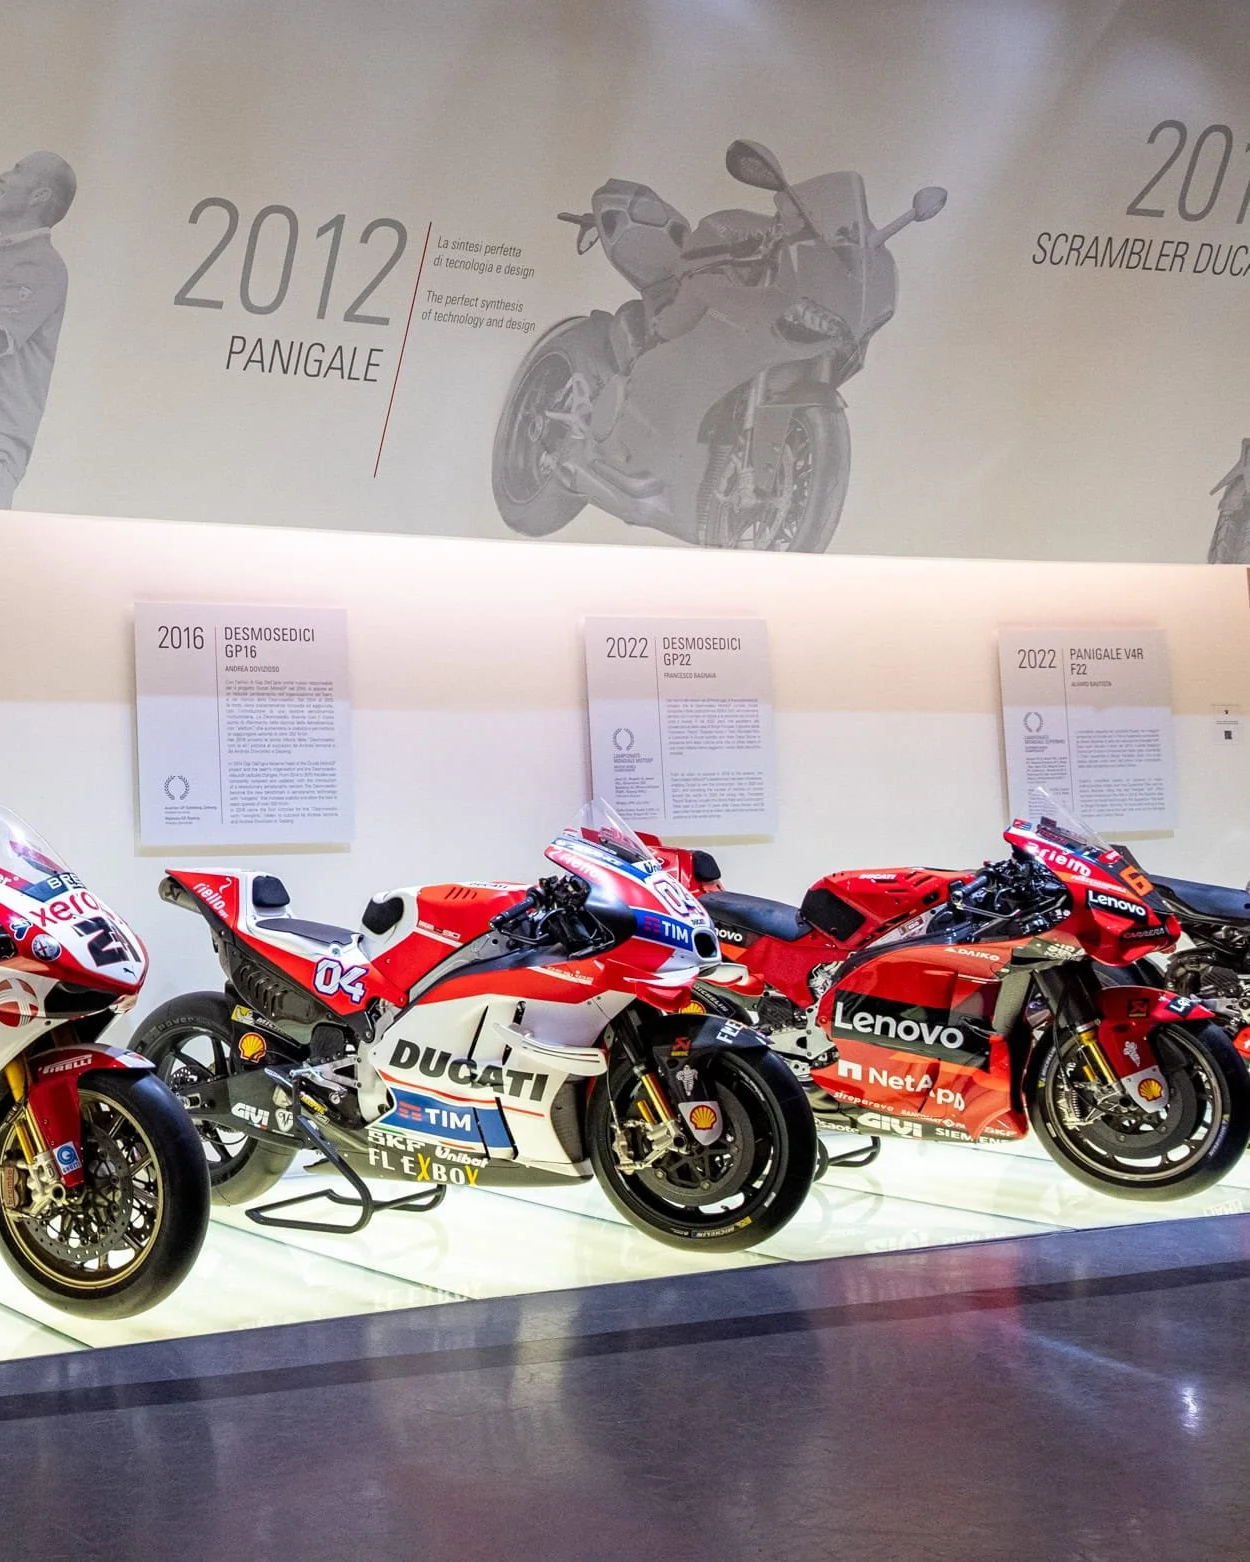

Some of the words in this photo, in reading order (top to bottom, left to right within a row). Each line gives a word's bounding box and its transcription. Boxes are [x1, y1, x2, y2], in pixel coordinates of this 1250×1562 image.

[437, 235, 449, 250] La
[450, 238, 483, 256] sintesi
[484, 241, 522, 260] perfetta
[1032, 232, 1190, 273] SCRAMBLER
[1193, 243, 1250, 277] DUC
[174, 197, 408, 325] 2012
[433, 255, 443, 267] di
[445, 257, 493, 274] tecnologia
[495, 264, 502, 273] e
[504, 263, 535, 280] design
[426, 290, 443, 304] The
[445, 292, 479, 310] perfect
[480, 297, 524, 314] synthesis
[421, 308, 432, 321] of
[433, 310, 484, 329] technology
[486, 316, 504, 328] and
[505, 318, 536, 333] design
[225, 336, 384, 382] PANIGALE
[158, 625, 204, 650] 2016
[224, 626, 315, 642] DESMOSEDICI
[662, 636, 741, 651] DESMOSEDICI
[225, 644, 257, 659] GP16
[606, 636, 649, 659] 2022
[663, 653, 692, 666] GP22
[1017, 649, 1057, 669] 2022
[1070, 647, 1122, 660] PANIGALE
[1125, 648, 1144, 660] V4R
[225, 665, 249, 673] ANDREA
[1070, 663, 1087, 676] F22
[193, 882, 226, 912] riello
[1088, 889, 1147, 917] Lenovo
[29, 891, 102, 928] xero
[662, 920, 689, 944] TIM
[714, 928, 744, 942] novo
[1123, 927, 1165, 938] CARRERA
[314, 957, 369, 1004] 04
[834, 1001, 965, 1049] Lenovo
[41, 1054, 93, 1075] PIRELLI
[389, 1038, 549, 1102] DUCATI
[833, 1090, 895, 1112] streparava
[231, 1102, 270, 1126] GIVI
[424, 1107, 472, 1132] TIM
[857, 1112, 922, 1138] GIVI
[367, 1130, 426, 1153] SKF
[435, 1145, 489, 1169] Unibat
